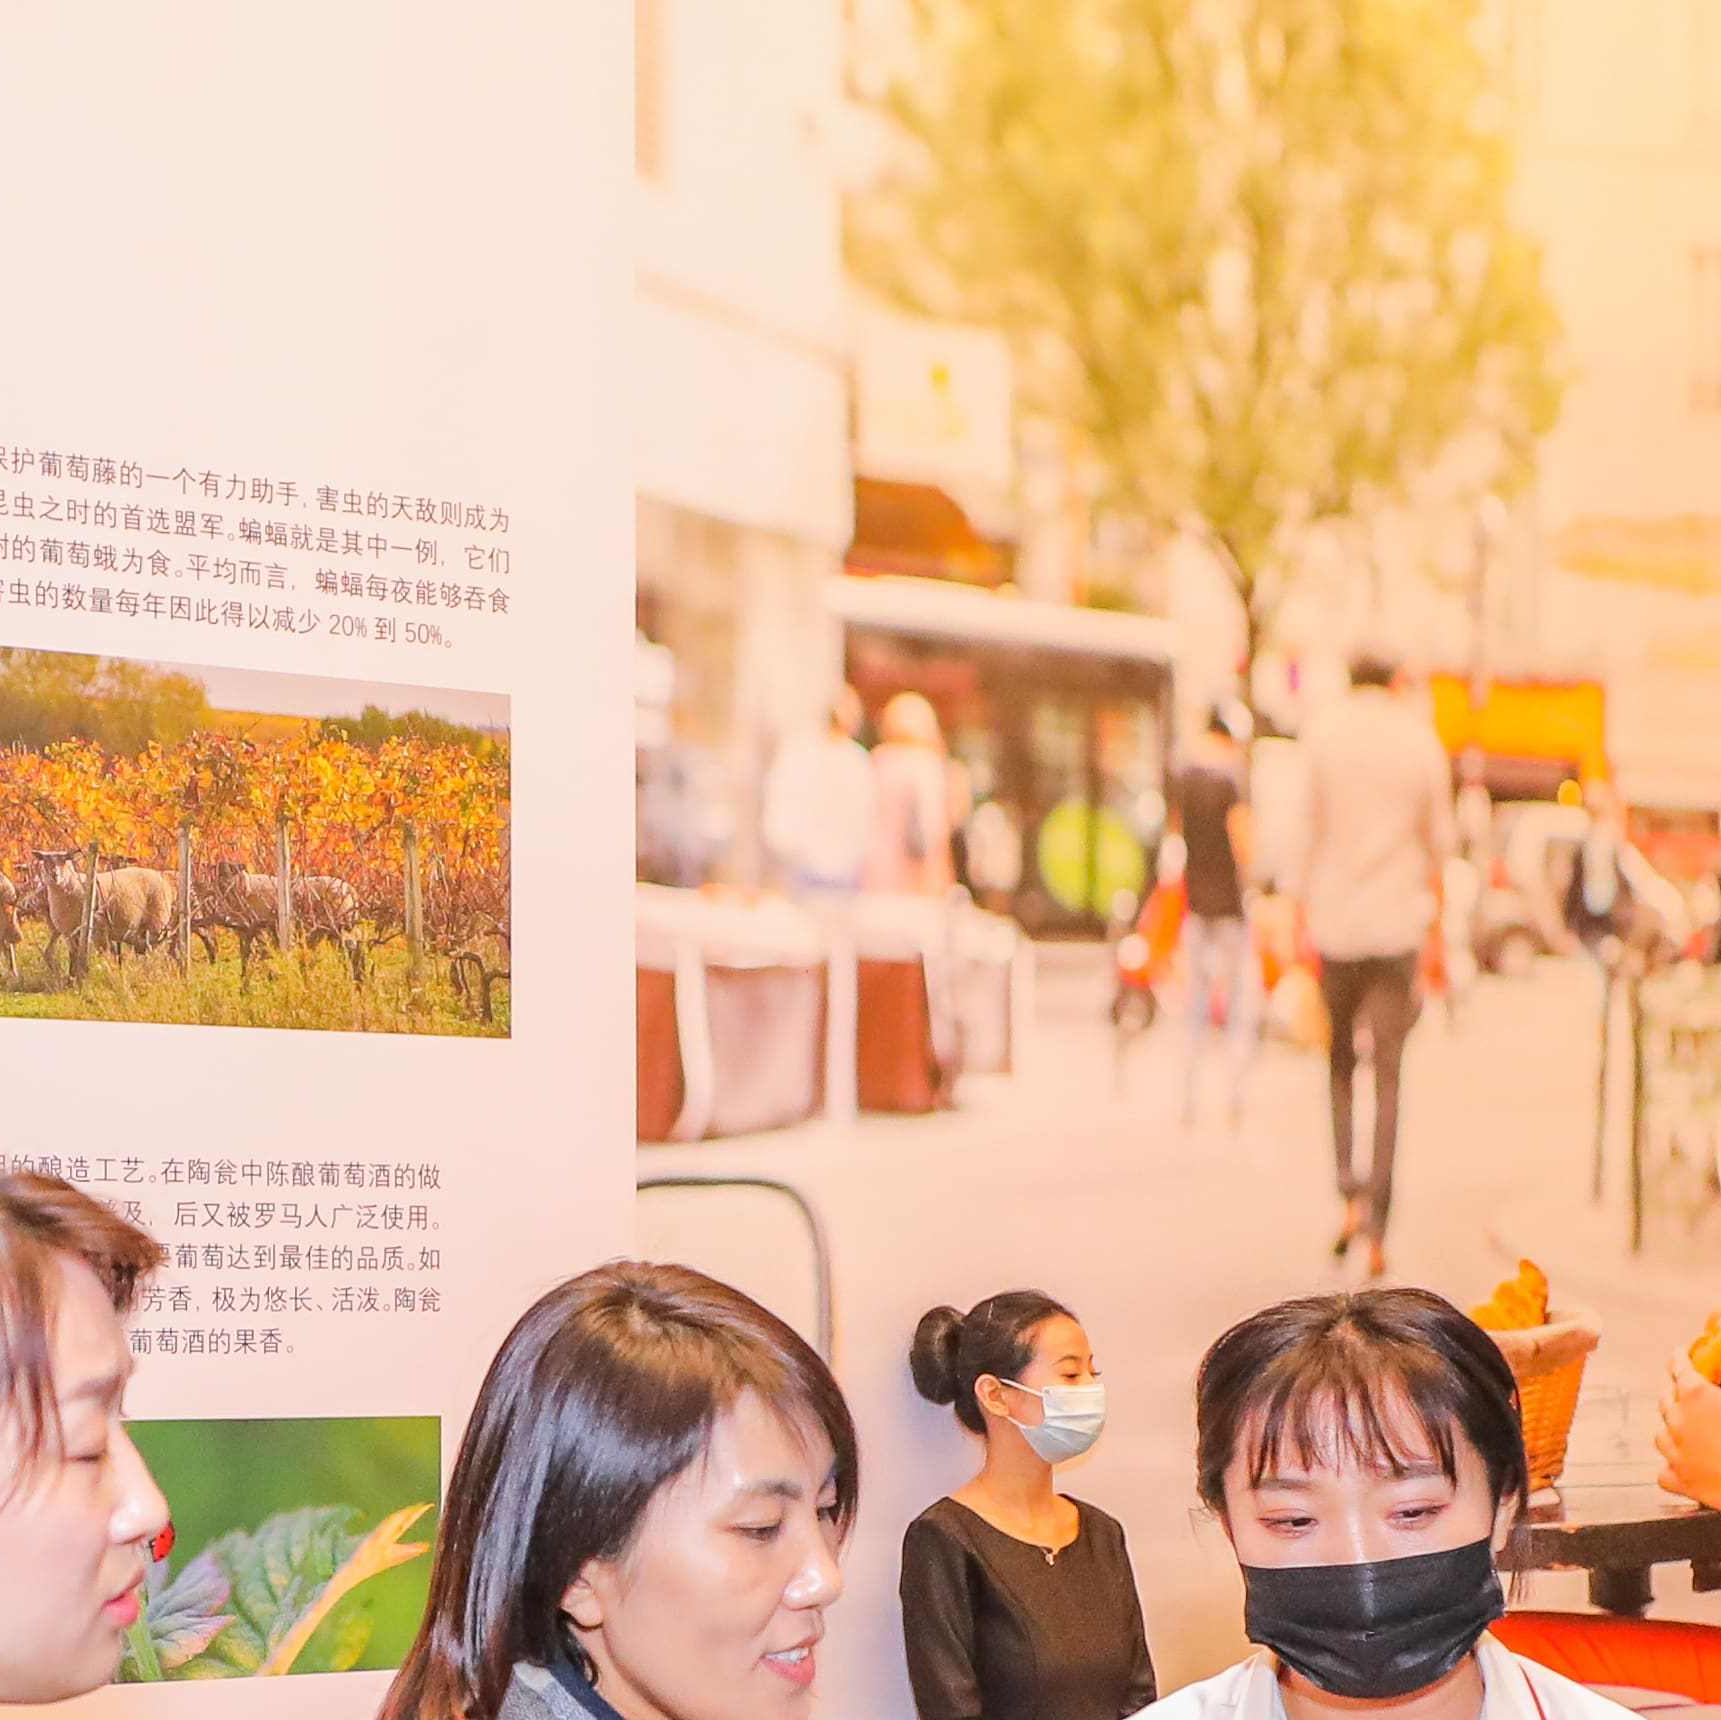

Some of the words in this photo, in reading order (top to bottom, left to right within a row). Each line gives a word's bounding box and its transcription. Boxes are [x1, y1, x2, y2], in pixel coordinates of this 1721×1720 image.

[328, 614, 368, 638] 20%
[375, 617, 397, 643] 到
[104, 1200, 440, 1231] 及，后又被罗马人广泛使用。
[134, 1285, 441, 1314] 芳香，极为悠长、活泼。陶瓮
[129, 1328, 295, 1355] 葡萄酒的果香。
